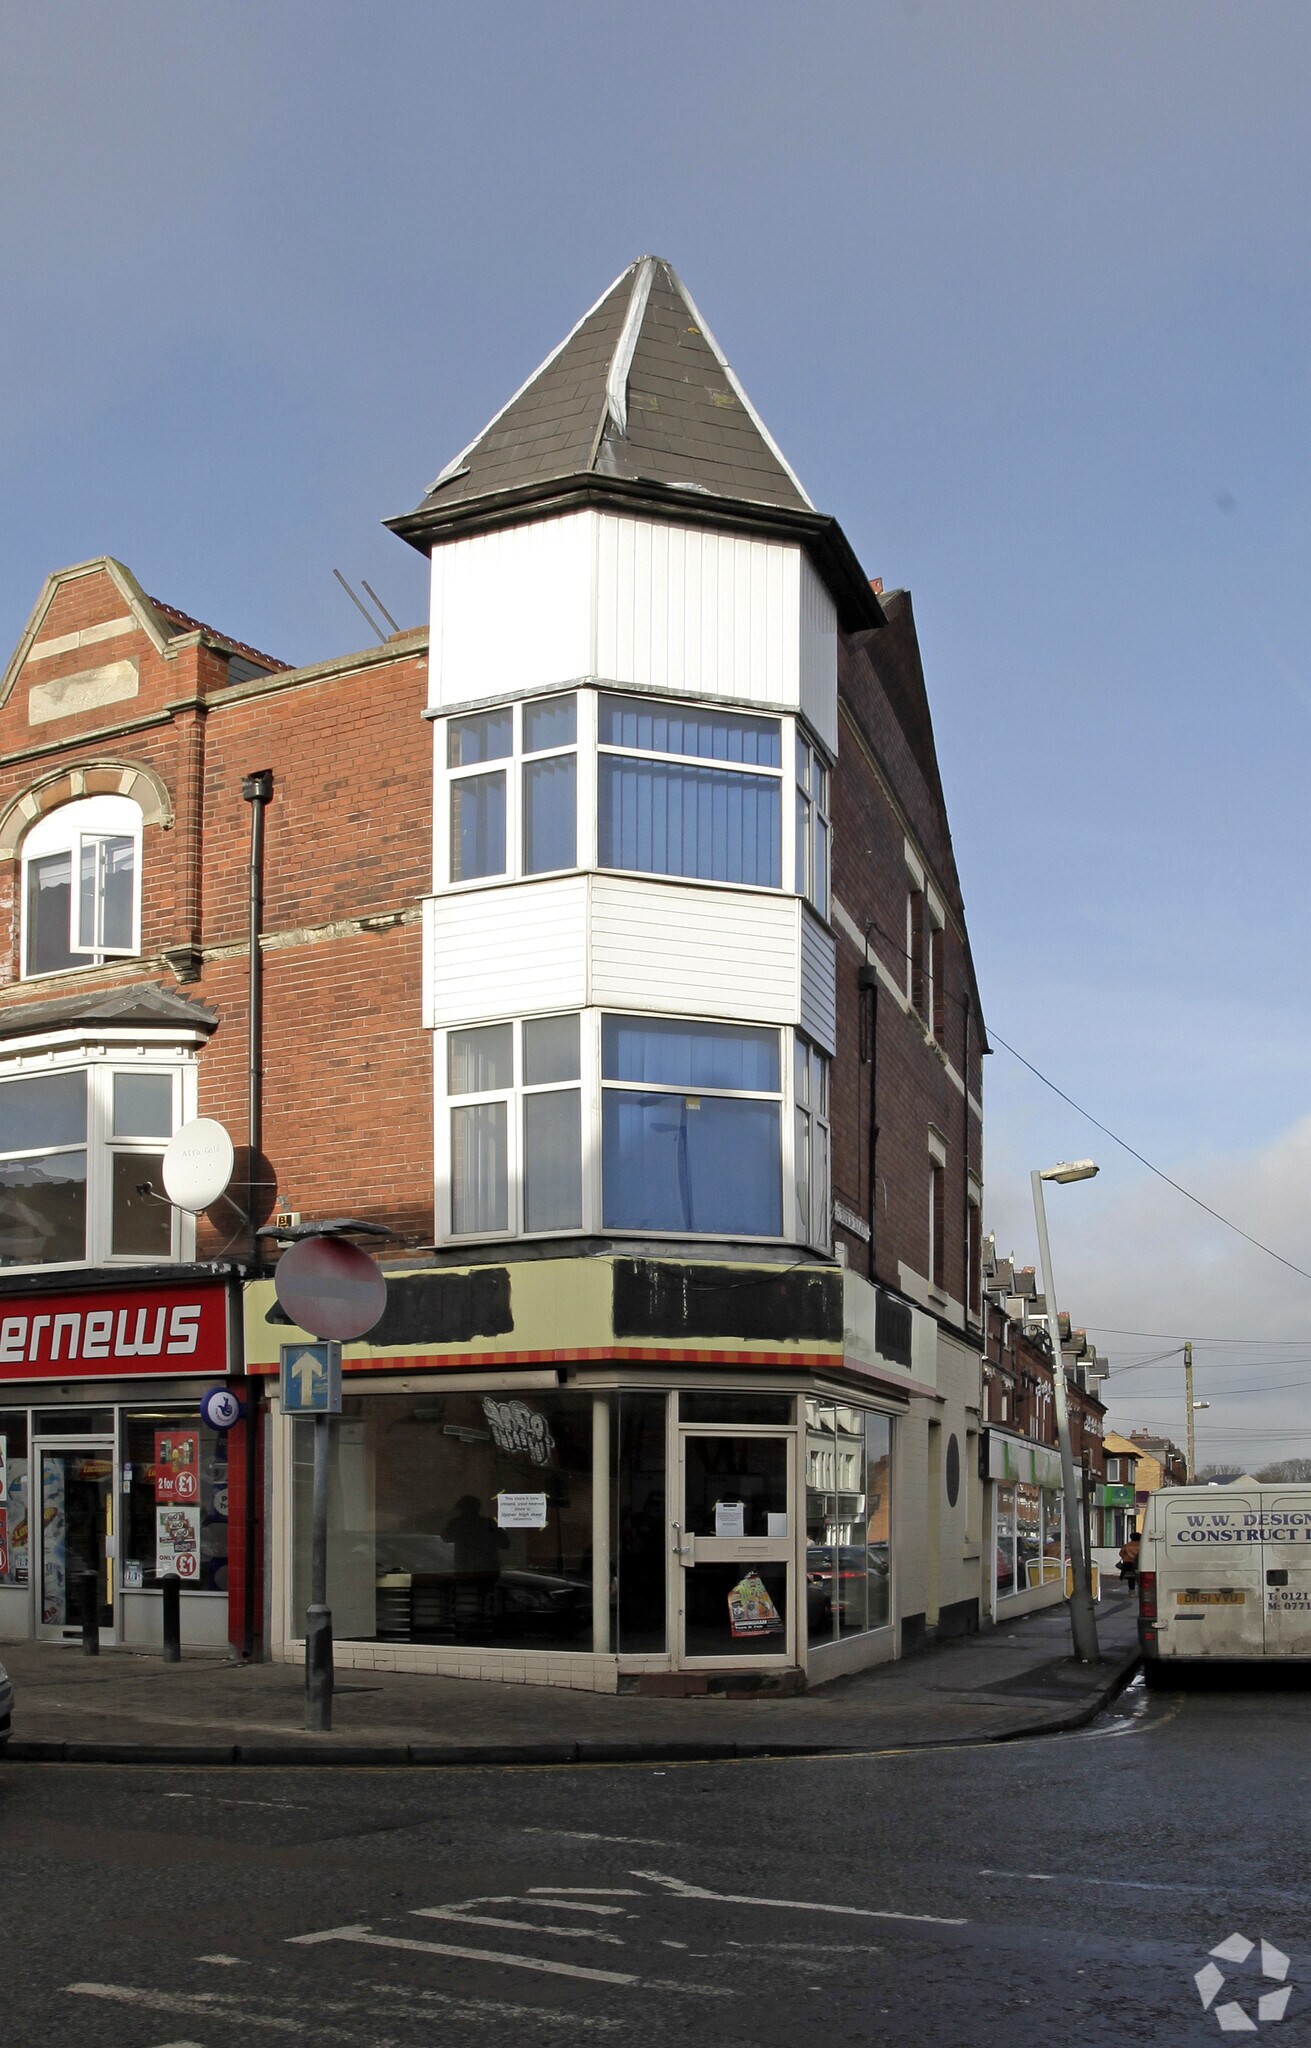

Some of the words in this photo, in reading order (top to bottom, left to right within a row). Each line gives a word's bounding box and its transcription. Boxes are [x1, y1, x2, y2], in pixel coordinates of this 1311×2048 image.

[158, 1477, 164, 1490] 2
[164, 1477, 174, 1490] for
[179, 1475, 193, 1492] £1
[1186, 1515, 1236, 1527] W.W.
[1177, 1528, 1299, 1542] CONSTRUCT
[179, 1555, 193, 1573] £1
[1267, 1592, 1278, 1601] T:
[1281, 1592, 1308, 1601] 0121
[1268, 1602, 1281, 1611] M:
[1284, 1602, 1311, 1611] 0771
